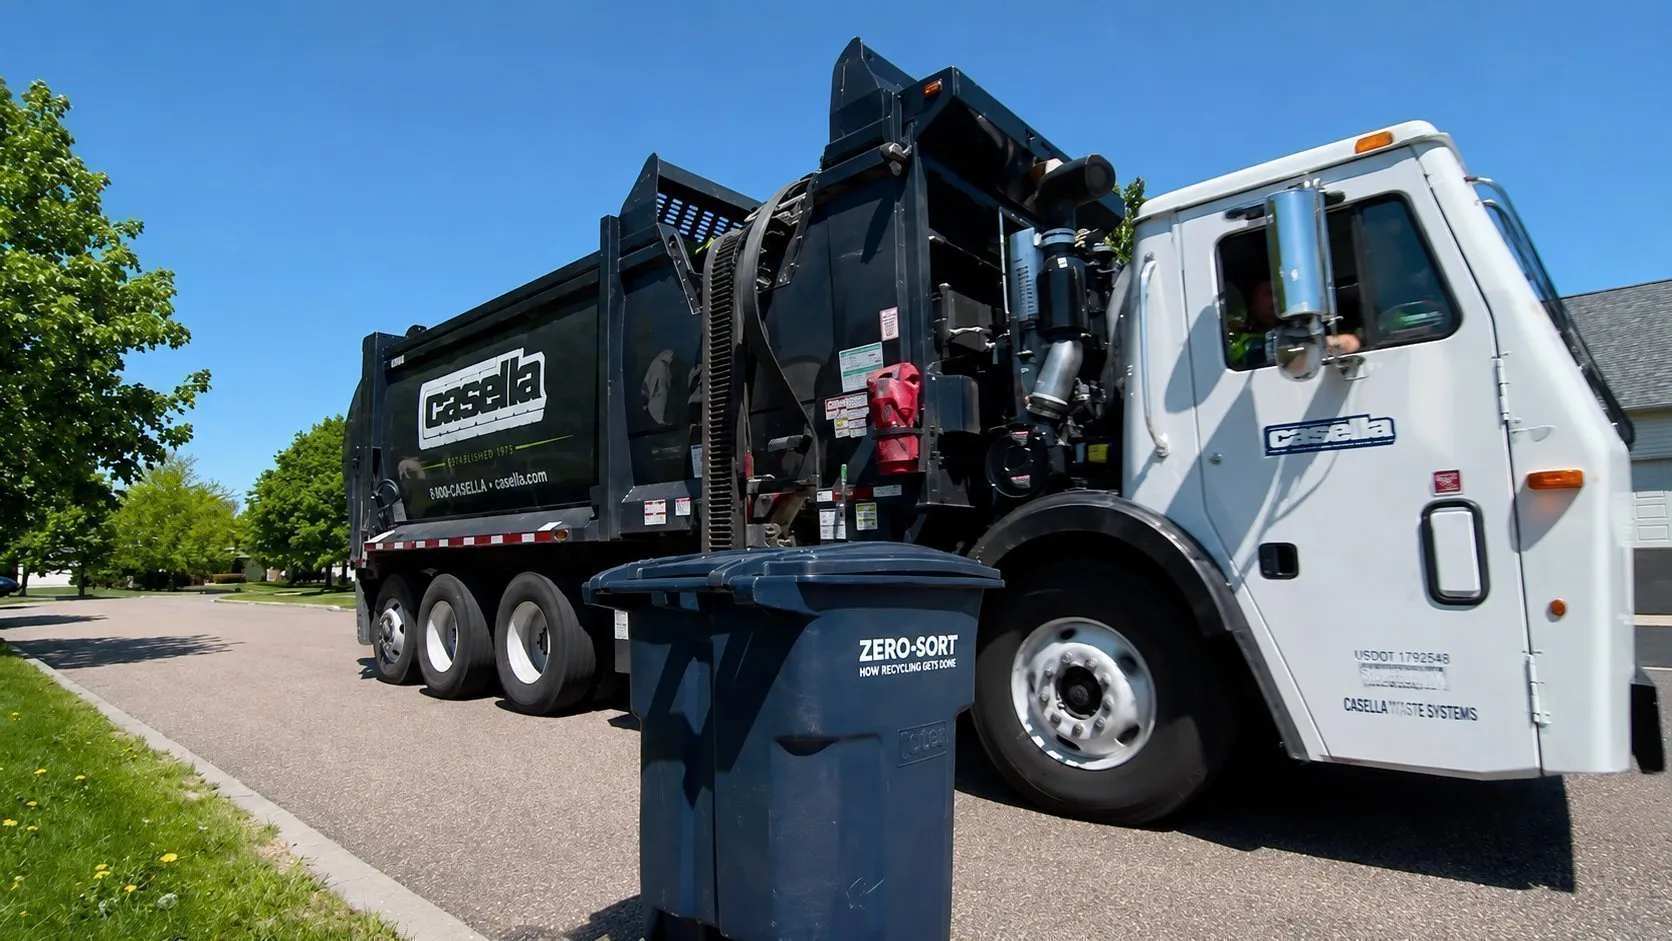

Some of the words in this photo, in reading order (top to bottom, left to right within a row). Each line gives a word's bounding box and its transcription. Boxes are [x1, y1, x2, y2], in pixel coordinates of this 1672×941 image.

[425, 356, 543, 429] casella
[1269, 417, 1393, 449] casella
[447, 449, 494, 468] ESTABLISHED
[496, 444, 514, 457] 1975
[494, 470, 548, 490] casella.com
[859, 634, 958, 662] ZERO-SORT
[1354, 649, 1394, 662] USDOT
[1398, 651, 1451, 665] 1792548
[859, 665, 880, 677] HOW
[881, 661, 921, 675] RECYCLING
[922, 660, 938, 671] GETS
[939, 658, 956, 669] DONE
[1343, 697, 1388, 714] CASELLA
[1427, 704, 1478, 721] SYSTEMS
